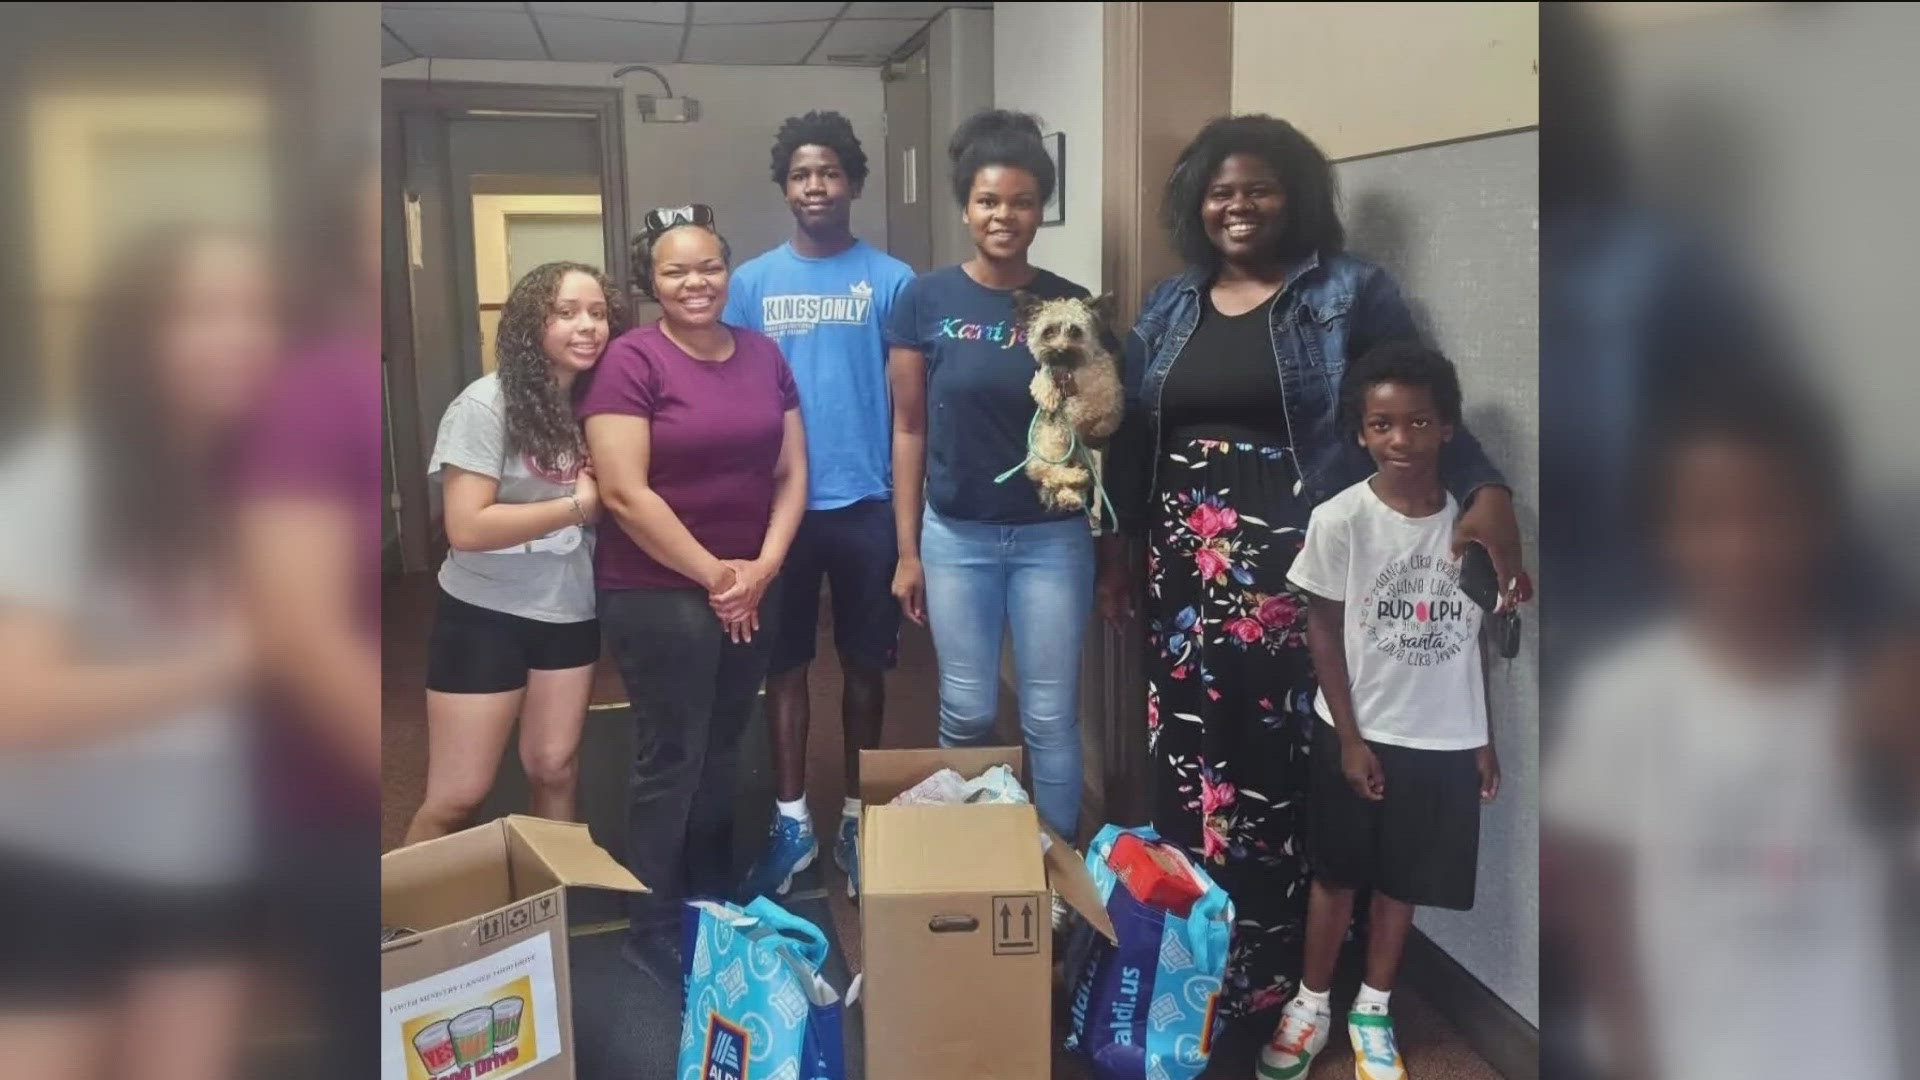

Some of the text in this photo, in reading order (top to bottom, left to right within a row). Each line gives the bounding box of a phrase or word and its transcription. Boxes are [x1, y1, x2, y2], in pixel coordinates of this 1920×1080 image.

[766, 298, 868, 321] KINGS ONLY
[1377, 600, 1463, 622] RUDOLPH
[1110, 966, 1141, 1047] aldi.us
[423, 1041, 455, 1069] YES
[473, 1047, 519, 1078] Drive
